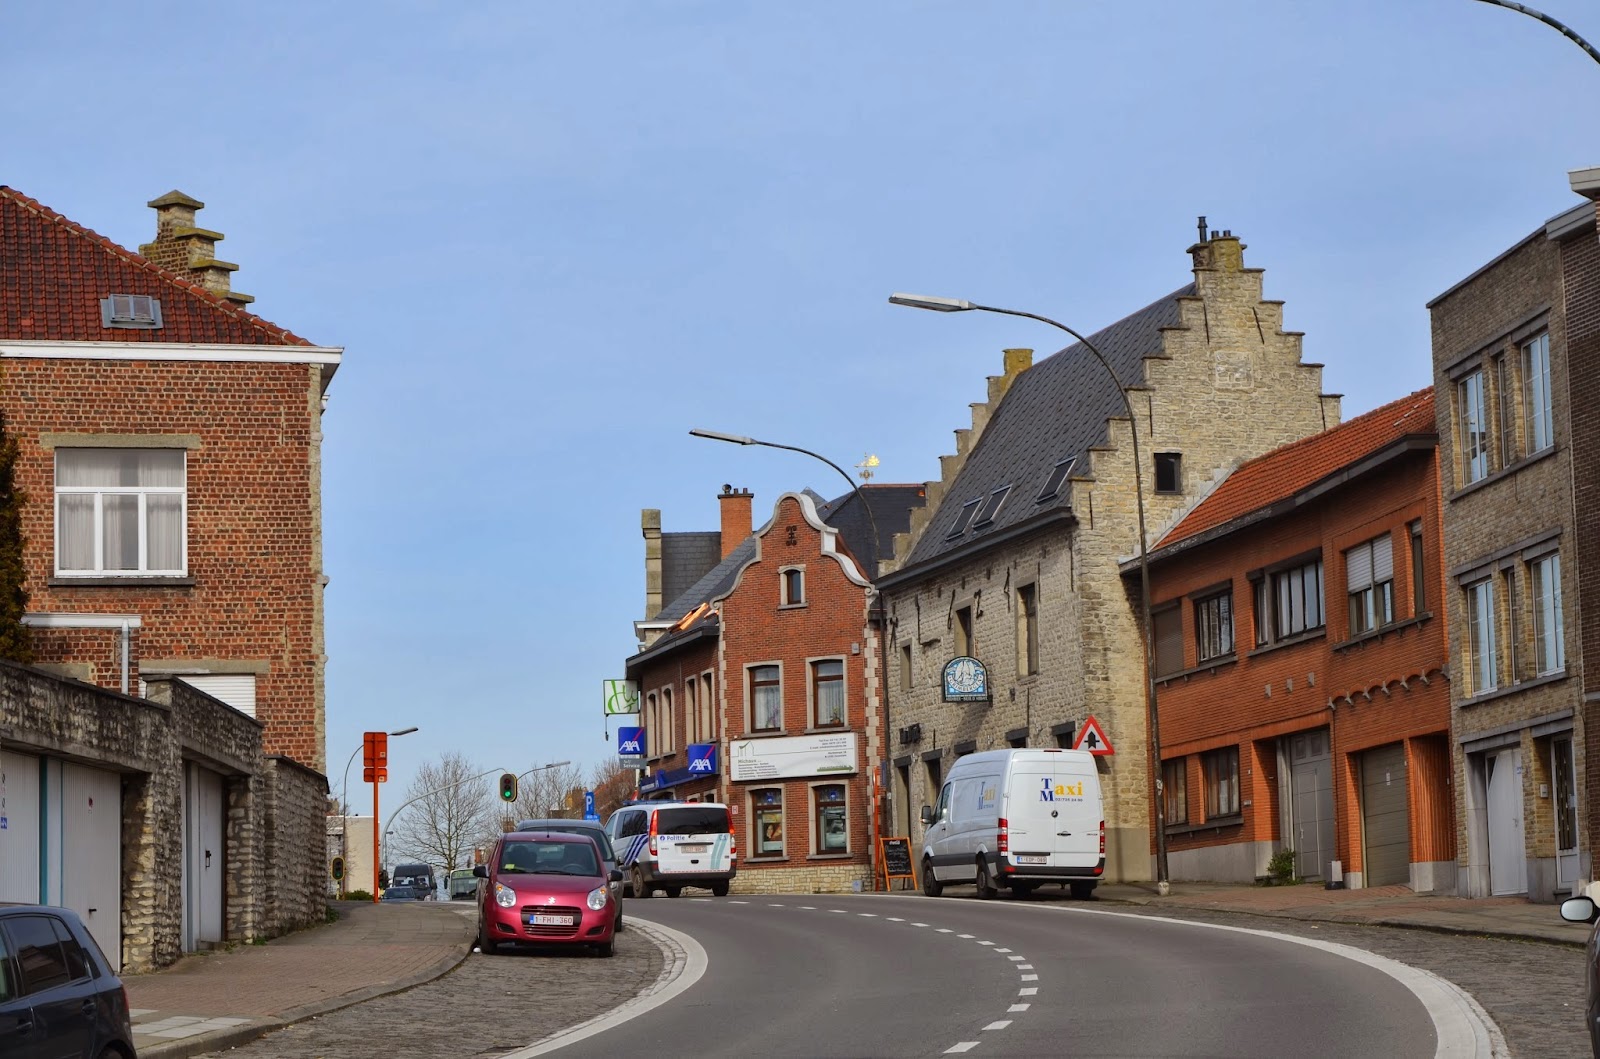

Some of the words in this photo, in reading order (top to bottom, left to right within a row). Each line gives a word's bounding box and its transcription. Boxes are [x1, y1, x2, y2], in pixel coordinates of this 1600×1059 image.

[619, 740, 640, 752] AXA
[688, 758, 712, 771] AXA
[586, 795, 592, 811] P
